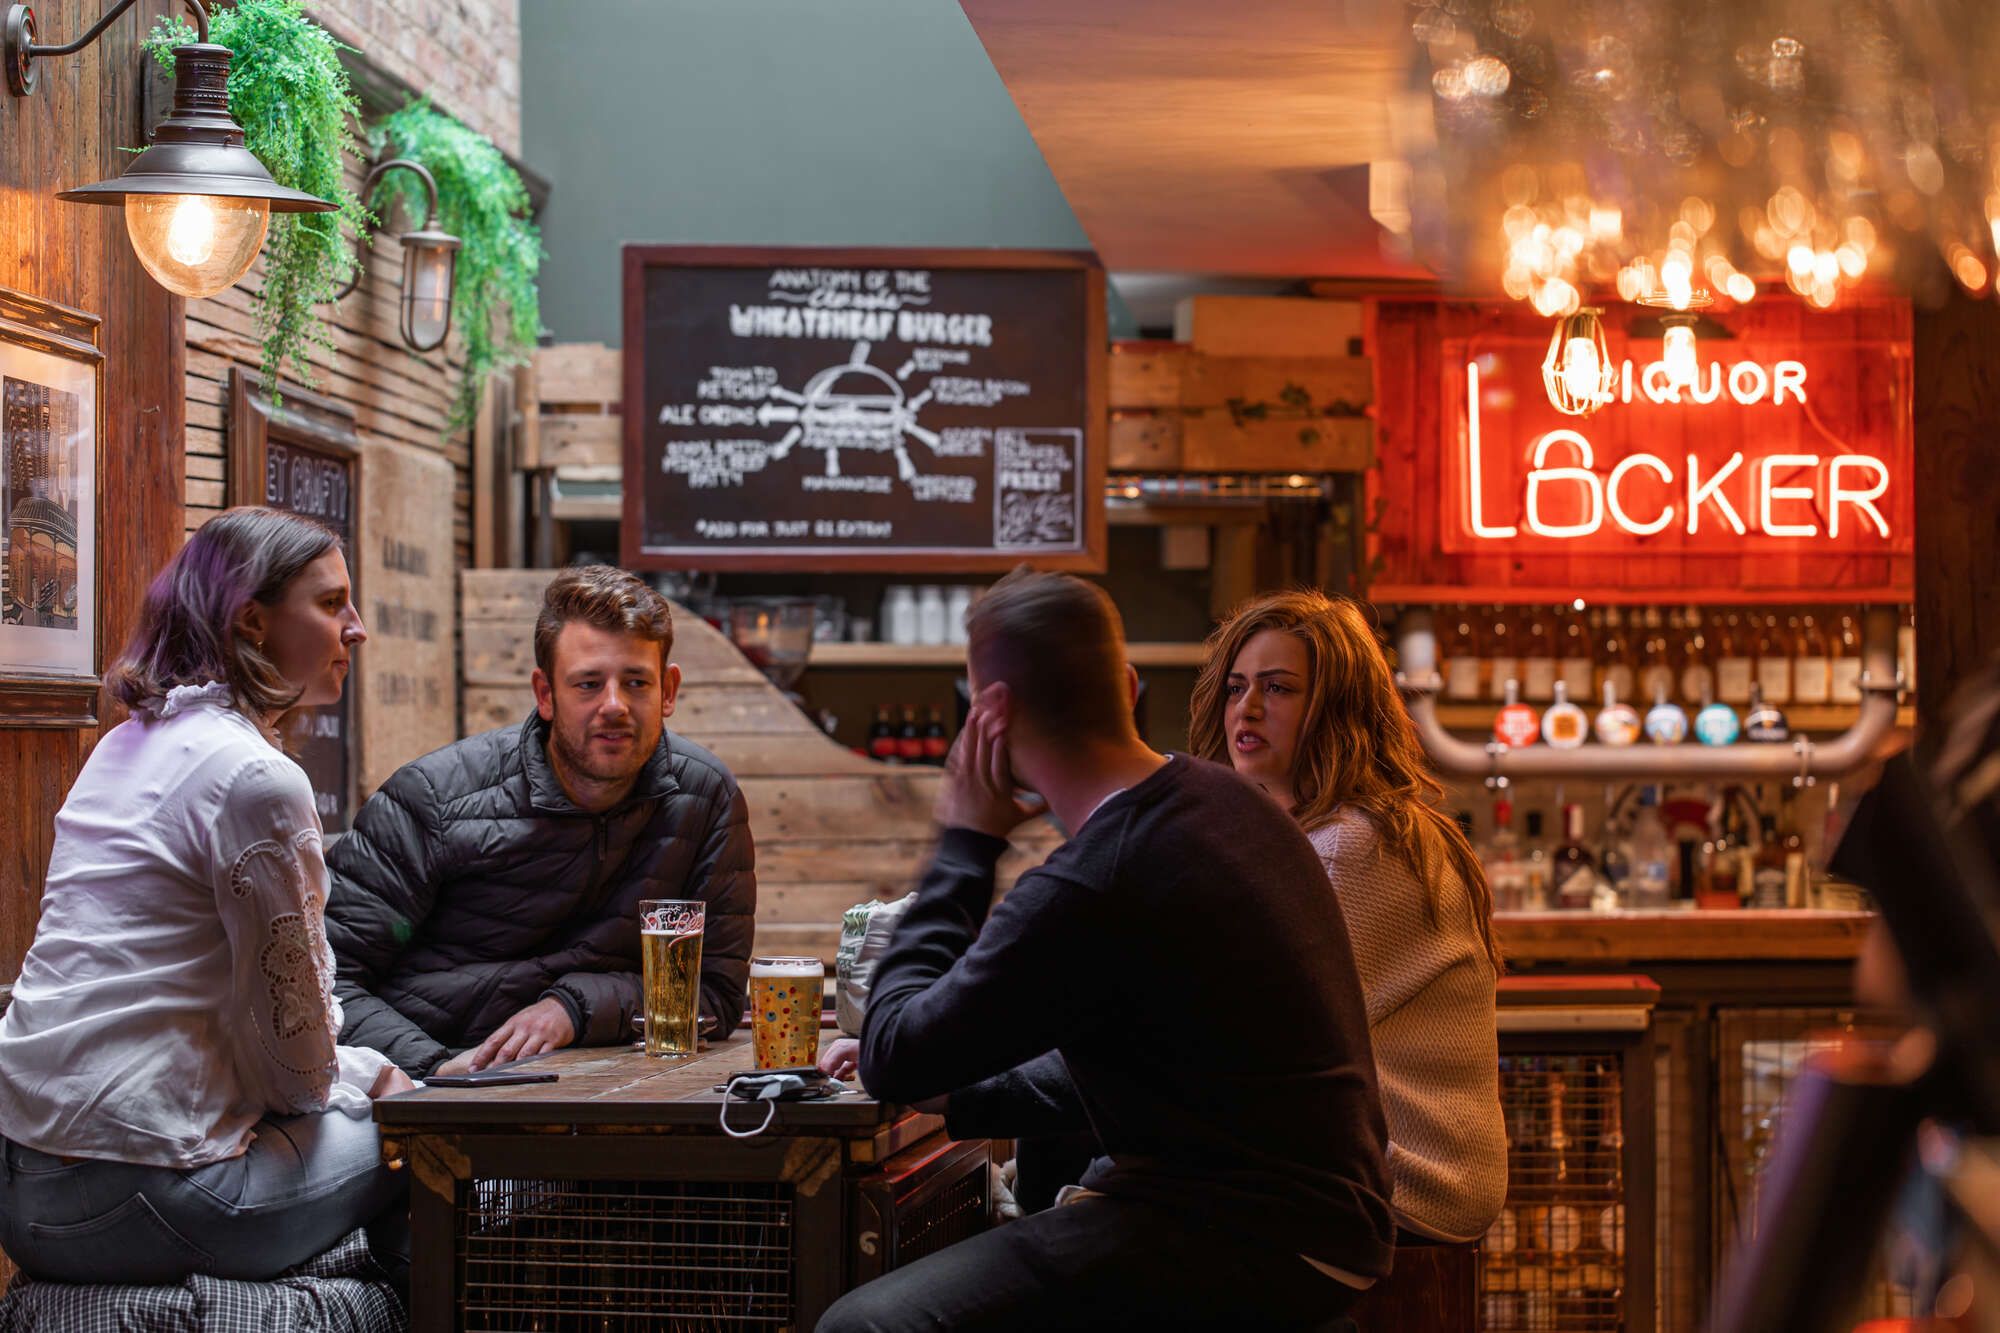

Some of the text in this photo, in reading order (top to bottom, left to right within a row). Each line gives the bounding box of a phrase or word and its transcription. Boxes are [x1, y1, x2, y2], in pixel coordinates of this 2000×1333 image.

[768, 269, 931, 292] ANATOMY OF THE
[897, 311, 993, 346] BURGER
[659, 404, 696, 426] ALE
[1467, 361, 1891, 539] LOCKER
